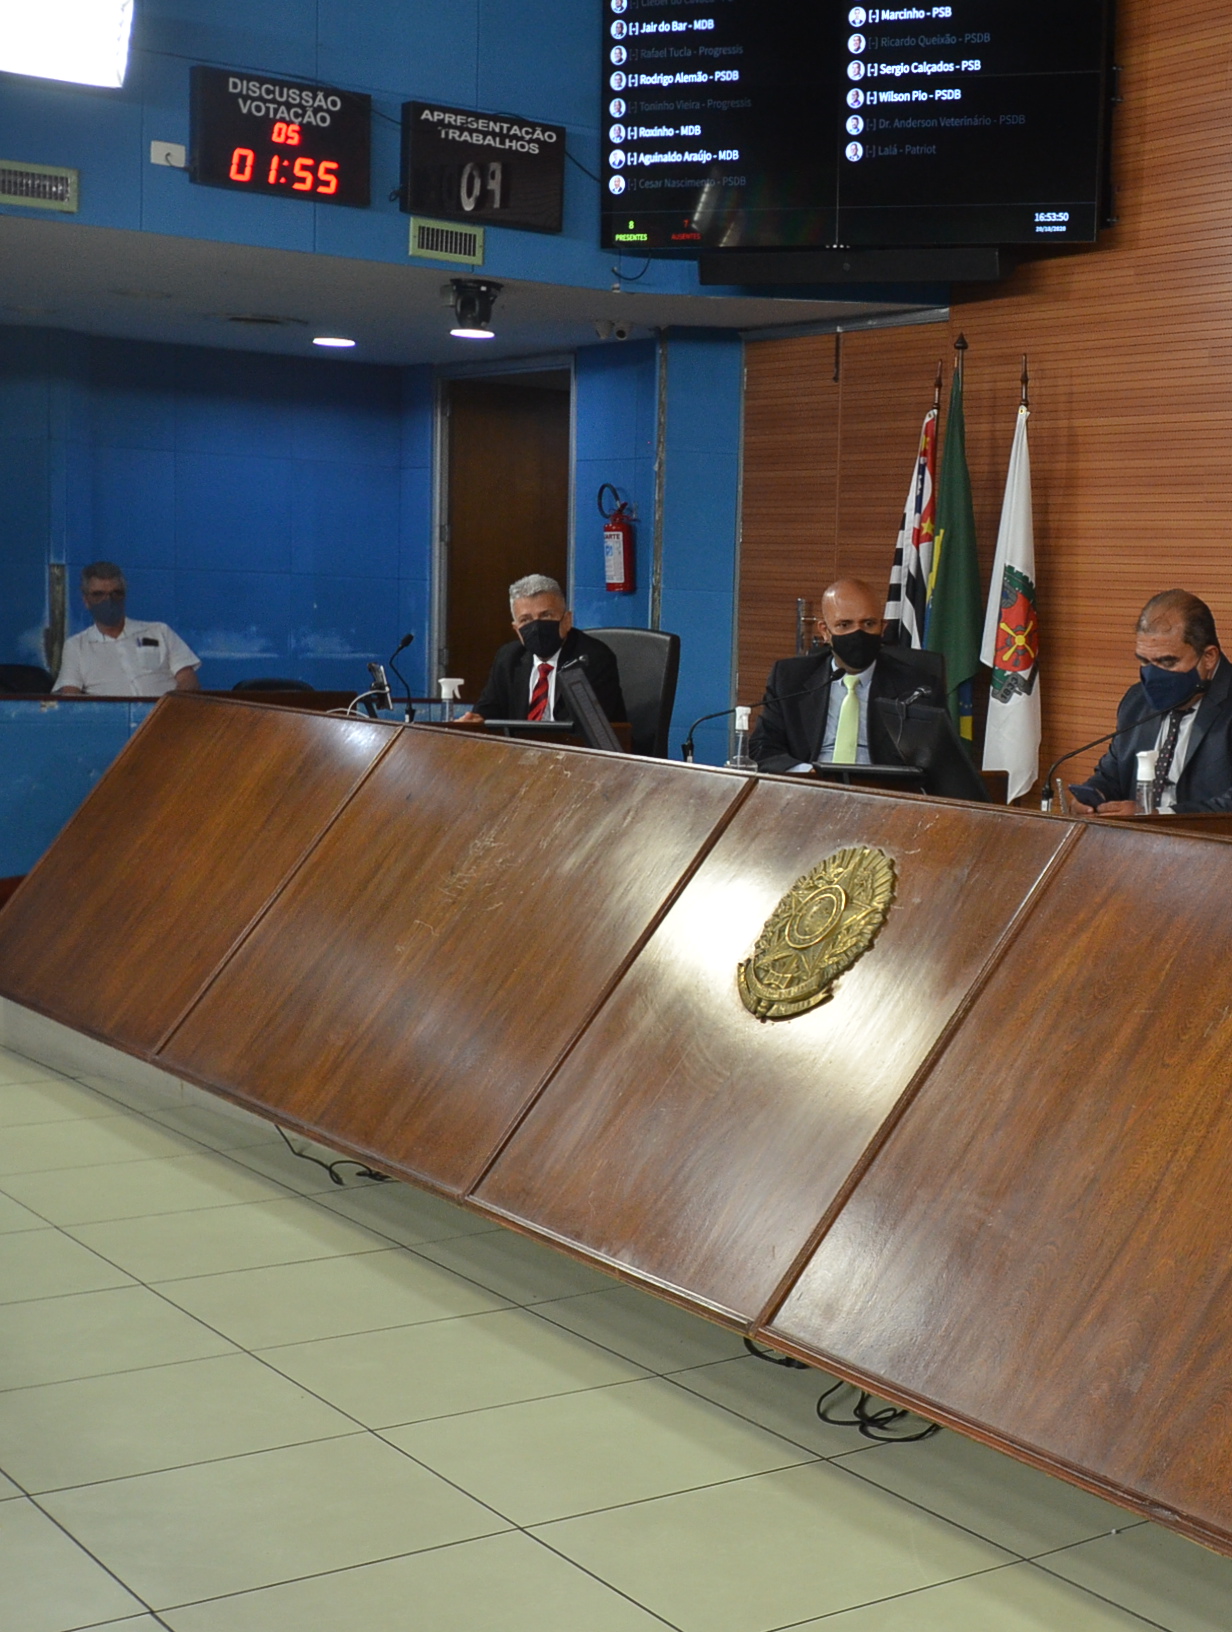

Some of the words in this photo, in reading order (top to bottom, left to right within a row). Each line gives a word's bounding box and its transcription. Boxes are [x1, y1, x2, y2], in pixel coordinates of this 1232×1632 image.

[881, 8, 925, 21] Marcinho
[931, 6, 952, 18] PSB
[640, 22, 657, 33] Jair
[658, 21, 670, 32] do
[671, 21, 687, 32] Bar
[693, 19, 715, 30] MDB
[881, 36, 916, 47] Ricardo
[918, 34, 956, 47] Queixão
[964, 33, 991, 44] PSDB
[879, 62, 909, 77] Sergio
[911, 60, 954, 75] Calçados
[961, 60, 981, 71] PSB
[640, 73, 674, 86] Rodrigo
[674, 71, 708, 83] Alemão
[714, 70, 739, 81] PSDB
[228, 77, 341, 111] DISCUSSÃO
[878, 90, 910, 103] Wilson
[912, 89, 928, 101] Pio
[935, 88, 961, 100] PSDB
[238, 98, 331, 127] VOTAÇÃO
[421, 109, 557, 143] APRESENTAÇÃO
[878, 118, 891, 129] Dr.
[893, 117, 937, 128] Anderson
[939, 115, 991, 127] Veterinário
[999, 114, 1026, 125] PSDB
[271, 122, 301, 146] 05
[639, 125, 674, 137] Roxinho
[680, 125, 701, 136] MDB
[437, 126, 540, 154] TRABALHOS
[878, 145, 897, 156] Lalá
[905, 143, 936, 155] Patriot
[638, 151, 682, 166] Aguinaldo
[683, 149, 712, 164] Araújo
[718, 149, 739, 161] MDB
[229, 147, 339, 195] 01:55
[1034, 211, 1070, 222] 16:53:50
[628, 220, 635, 230] 8
[615, 233, 648, 241] PRESENTES
